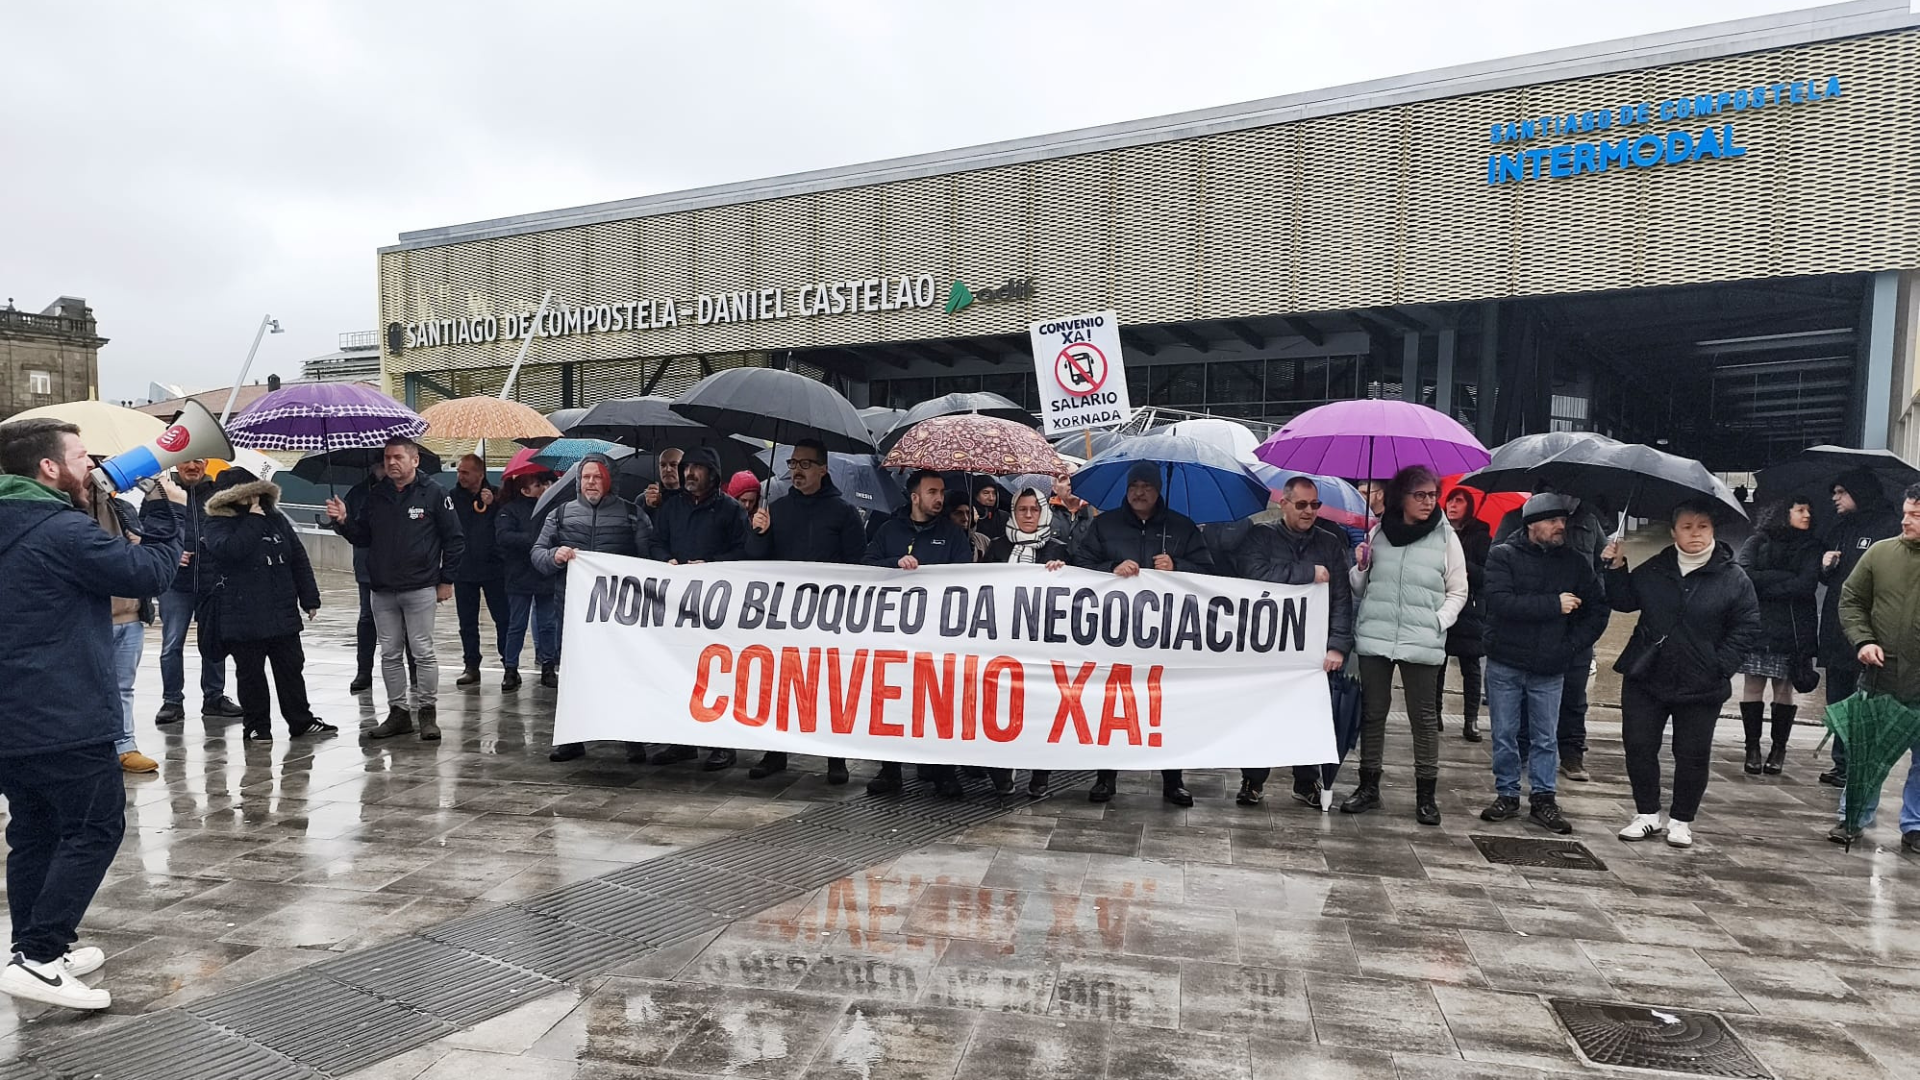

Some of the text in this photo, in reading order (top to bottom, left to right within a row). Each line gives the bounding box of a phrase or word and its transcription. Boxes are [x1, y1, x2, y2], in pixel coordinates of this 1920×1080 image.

[1489, 76, 1841, 144] SANTIAGO DE COMPOSTELA
[1487, 124, 1747, 185] INTERMODAL
[976, 277, 1034, 301] adif
[406, 314, 497, 349] SANTIAGO
[505, 312, 530, 341] DE
[537, 298, 678, 339] COMPOSTELA
[698, 288, 789, 326] DANIEL
[799, 273, 936, 317] CASTELAO
[1039, 316, 1104, 335] CONVENIO
[1062, 329, 1092, 345] XA!
[1051, 391, 1118, 412] SALARIO
[1052, 410, 1122, 429] XORNADA
[586, 575, 1307, 653] NON AO BLOQUEO DA NEGOCIACIÓN
[689, 643, 1163, 747] CONVENIO XA!
